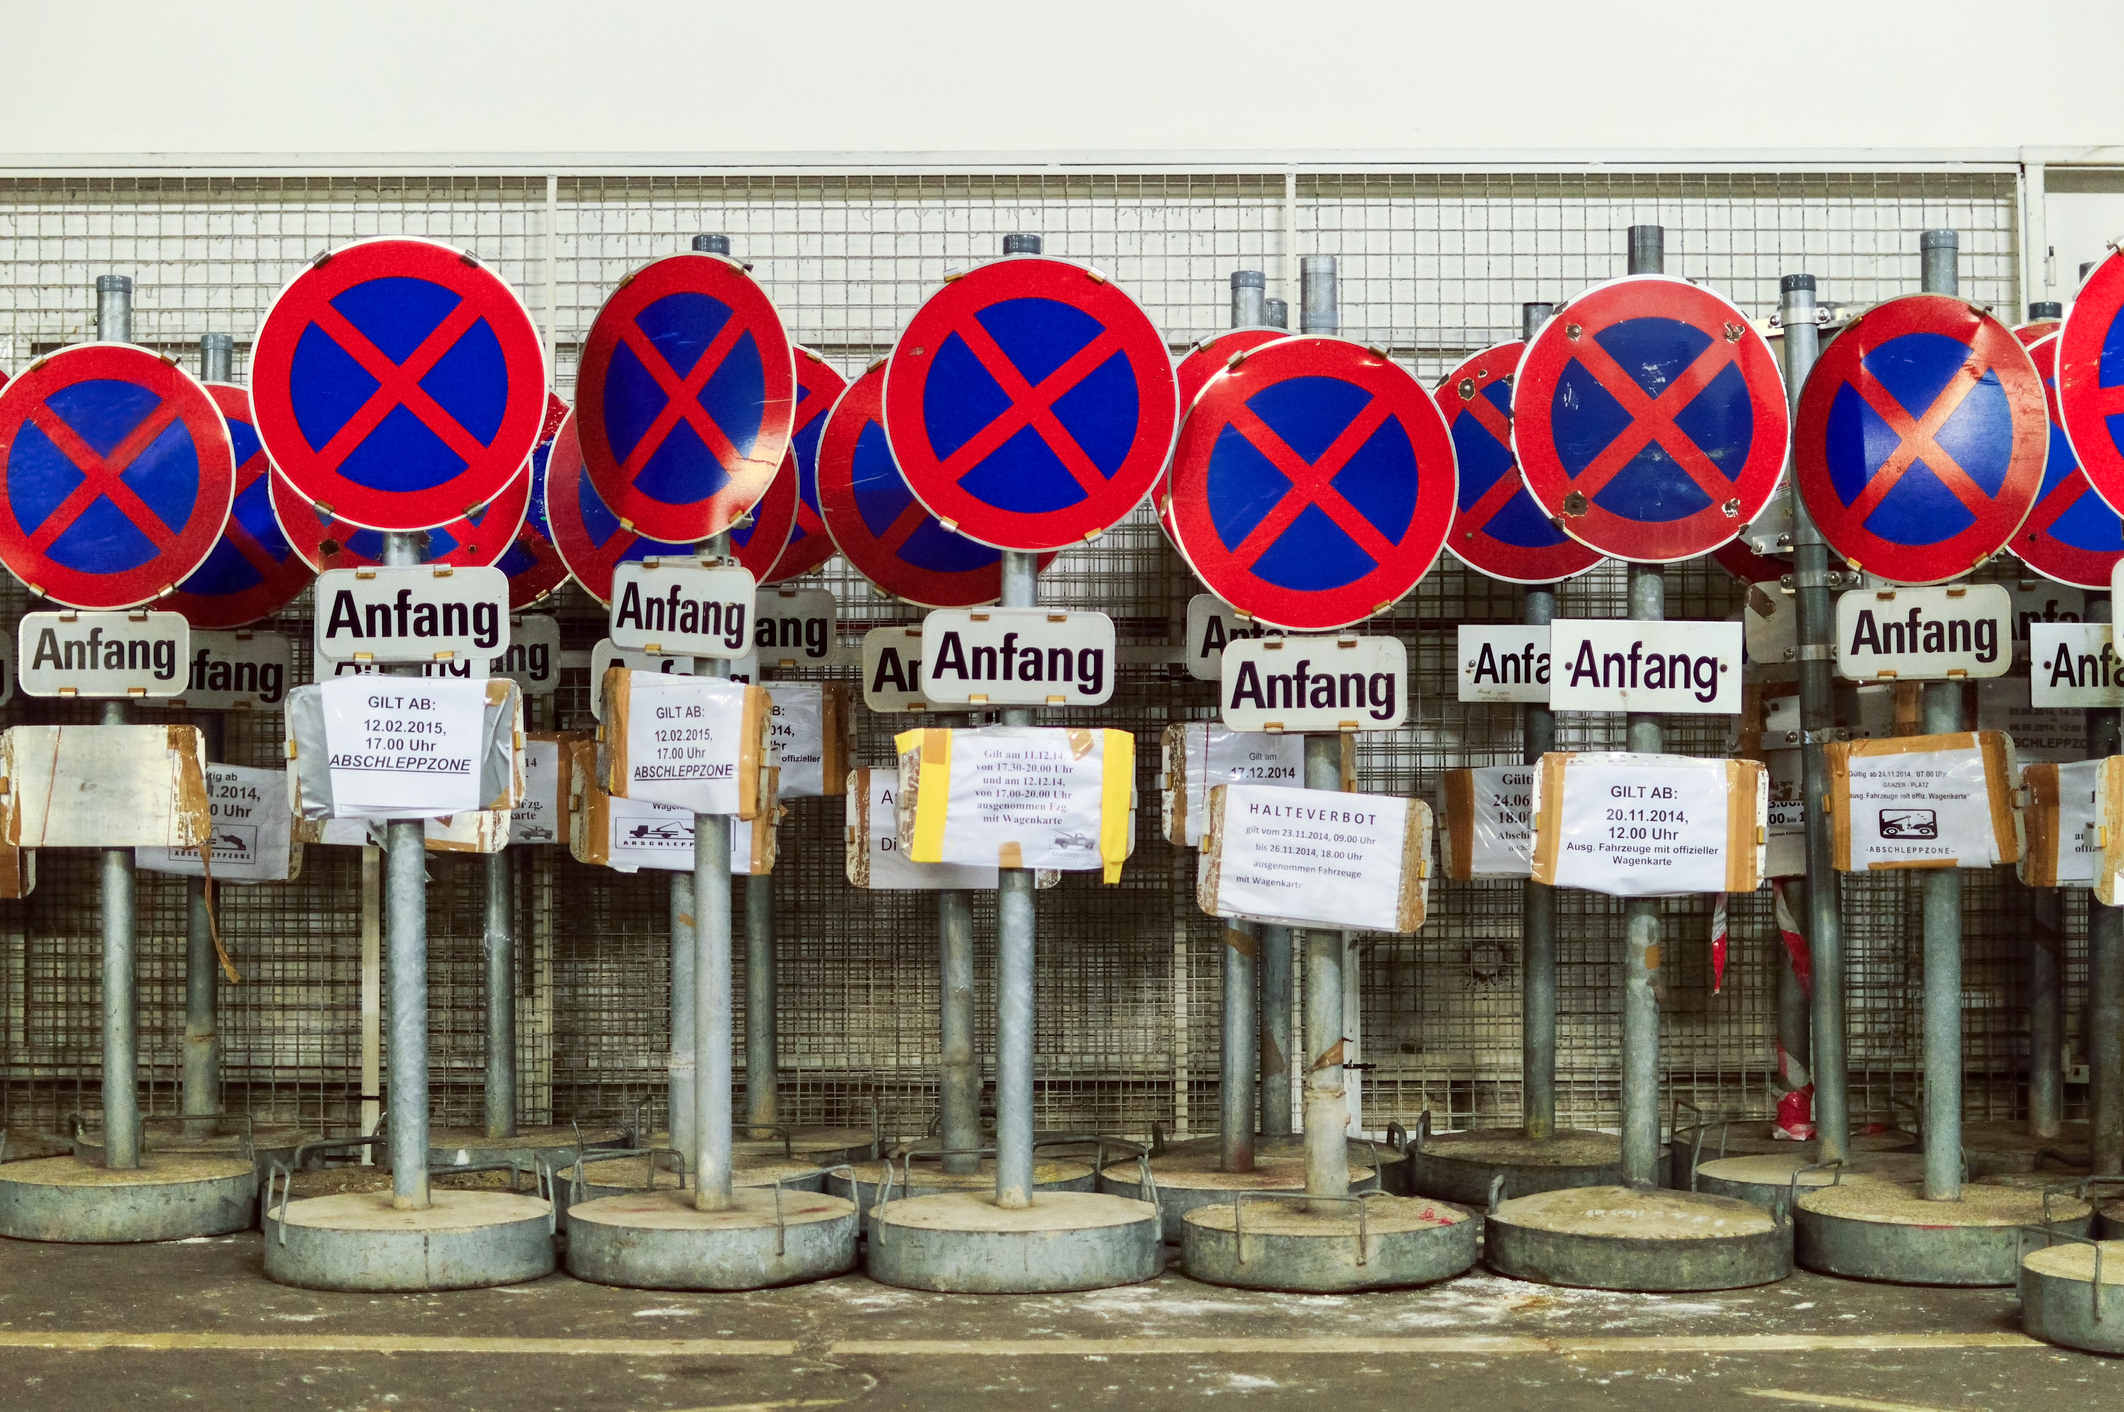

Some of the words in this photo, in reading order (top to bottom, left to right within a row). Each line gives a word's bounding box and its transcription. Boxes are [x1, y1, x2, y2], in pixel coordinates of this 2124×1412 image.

[326, 589, 499, 648] Anfang
[616, 581, 746, 649] Anfang
[1850, 607, 1998, 663] Anfang
[32, 628, 175, 680] Anfang
[931, 631, 1104, 695] Anfang
[187, 649, 284, 703] fang
[1570, 640, 1718, 703] Anfang
[1230, 659, 1396, 720] Anfang
[368, 696, 404, 709] GILT
[408, 698, 436, 711] AB:
[656, 706, 682, 719] GILT
[685, 705, 705, 718] AB:
[364, 719, 447, 736] 12.02.2015,
[655, 728, 713, 742] 12.02.2015,
[365, 737, 404, 751] 17.00
[409, 739, 437, 752] Uhr
[657, 747, 684, 760] 17.00
[687, 746, 706, 759] Uhr
[781, 754, 821, 763] offizieller
[984, 749, 1003, 759] Gilt
[1249, 752, 1263, 761] Gilt
[1264, 753, 1277, 761] am
[330, 754, 472, 772] ABSCHLEPPZONE
[997, 763, 1051, 773] 17.30-20.00
[1055, 765, 1074, 774] Uhr
[225, 773, 238, 782] ab
[634, 764, 734, 778] ABSCHLEPPZONE
[1230, 766, 1296, 779] 17.12.2014
[983, 776, 1002, 785] und
[1024, 777, 1066, 787] 12.12.14,
[996, 789, 1050, 799] 17.00-20.00
[1054, 790, 1073, 799] Uhr
[1610, 785, 1647, 799] GILT
[1650, 787, 1678, 800] AB:
[1866, 792, 1898, 800] Fahrzeuge
[224, 804, 252, 818] Uhr
[977, 802, 1046, 811] ausgenommen
[1049, 802, 1070, 813] Fzg.
[1249, 803, 1377, 826] HALTEVERBOT
[983, 814, 999, 823] mit
[1002, 814, 1063, 826] Wagenkarte
[1606, 808, 1689, 825] 20.11.2014,
[1245, 826, 1260, 835] gilt
[1261, 829, 1280, 837] vom
[1282, 828, 1331, 842] 23.11.2014,
[1333, 833, 1358, 844] 09.00
[1360, 836, 1377, 845] Uhr
[1608, 826, 1647, 840] 12.00
[1652, 828, 1679, 841] Uhr
[1255, 843, 1268, 852] bis
[1269, 844, 1319, 858] 26.11.2014,
[1321, 850, 1345, 860] 18.00
[1347, 852, 1363, 861] Uhr
[1566, 842, 1596, 853] Ausg.
[1599, 843, 1651, 855] Fahrzeuge
[1654, 845, 1670, 854] mit
[1673, 845, 1719, 855] offizieller
[1612, 856, 1672, 867] Wagenkarte
[1253, 860, 1316, 874] ausgenommen
[1317, 866, 1362, 879] Fahrzeuge
[1236, 875, 1250, 884] mit
[1252, 876, 1304, 889] Wagenkarte
